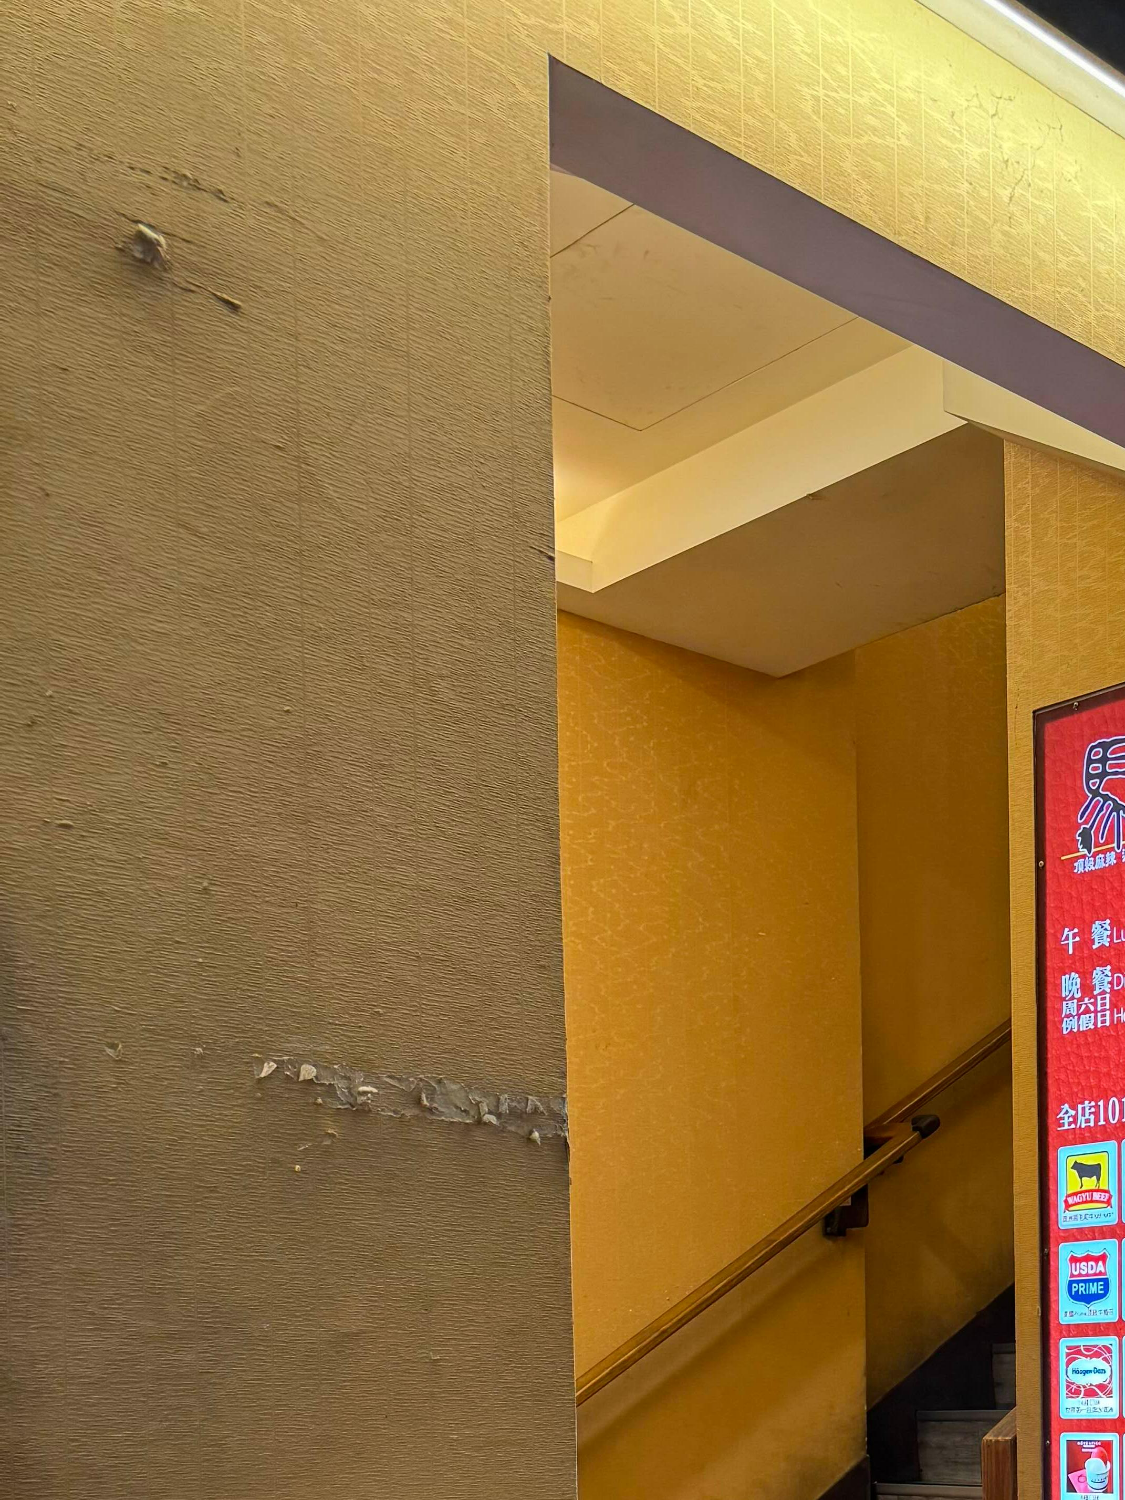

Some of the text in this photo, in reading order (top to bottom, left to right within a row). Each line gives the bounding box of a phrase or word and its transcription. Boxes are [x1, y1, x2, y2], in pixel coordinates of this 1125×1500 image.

[1061, 993, 1111, 1018] 周六日
[1061, 1010, 1111, 1036] 例假日
[1070, 1259, 1105, 1276] USDA
[1071, 1281, 1105, 1296] PRIME
